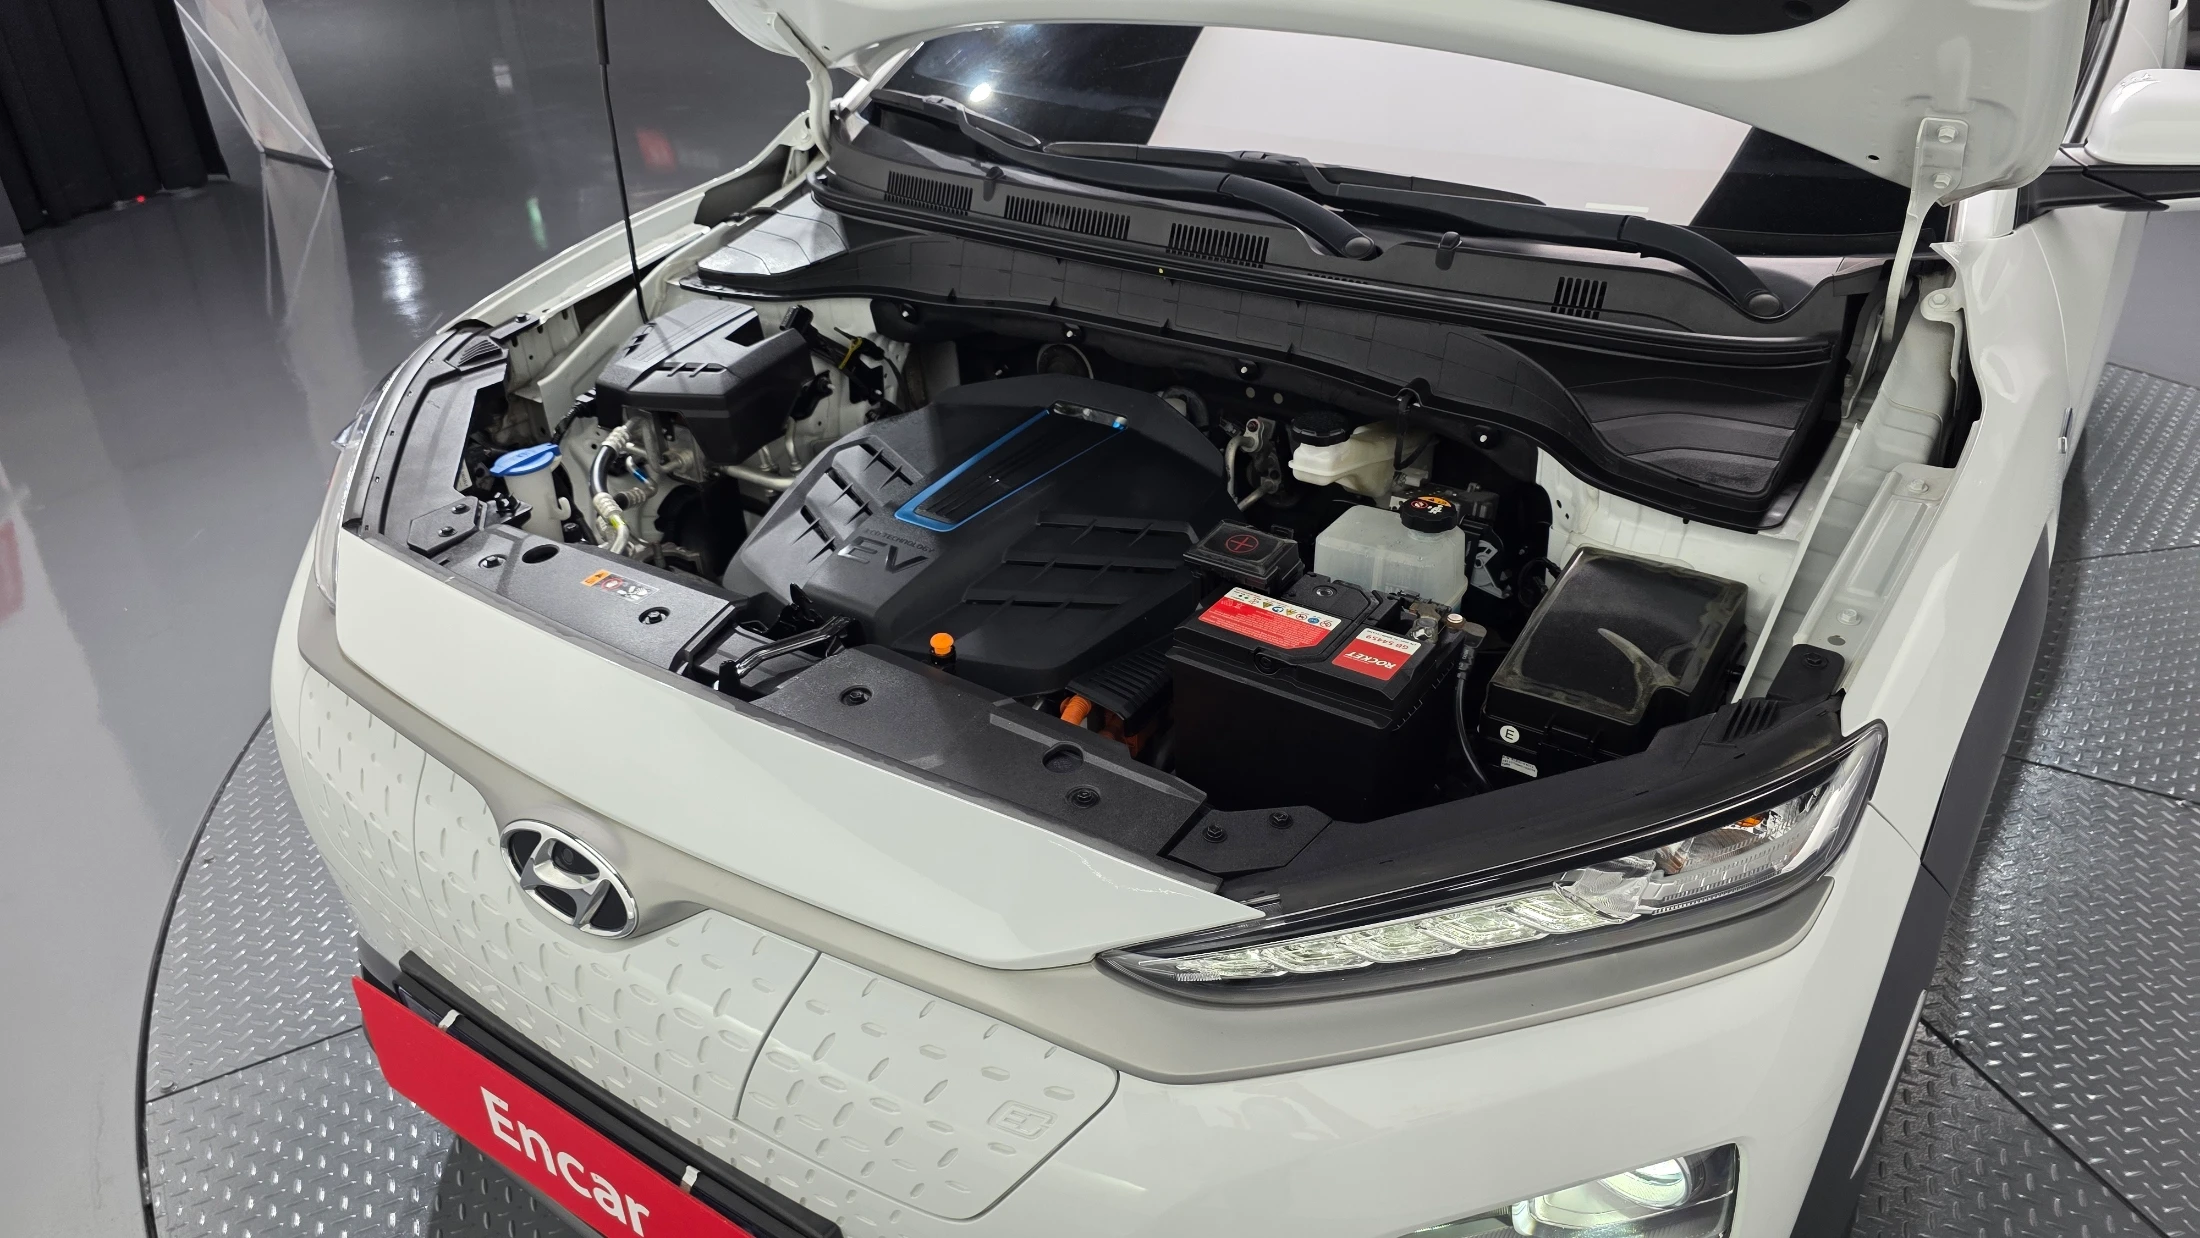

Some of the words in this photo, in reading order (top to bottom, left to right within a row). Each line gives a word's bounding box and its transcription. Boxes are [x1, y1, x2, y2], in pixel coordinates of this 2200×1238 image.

[882, 533, 935, 553] TECHNOLOGY
[838, 536, 929, 574] EV
[1365, 634, 1395, 648] 54459
[1395, 643, 1409, 651] GB
[1343, 651, 1397, 670] ROCKET
[1505, 728, 1515, 741] E
[480, 1086, 650, 1238] Encar
